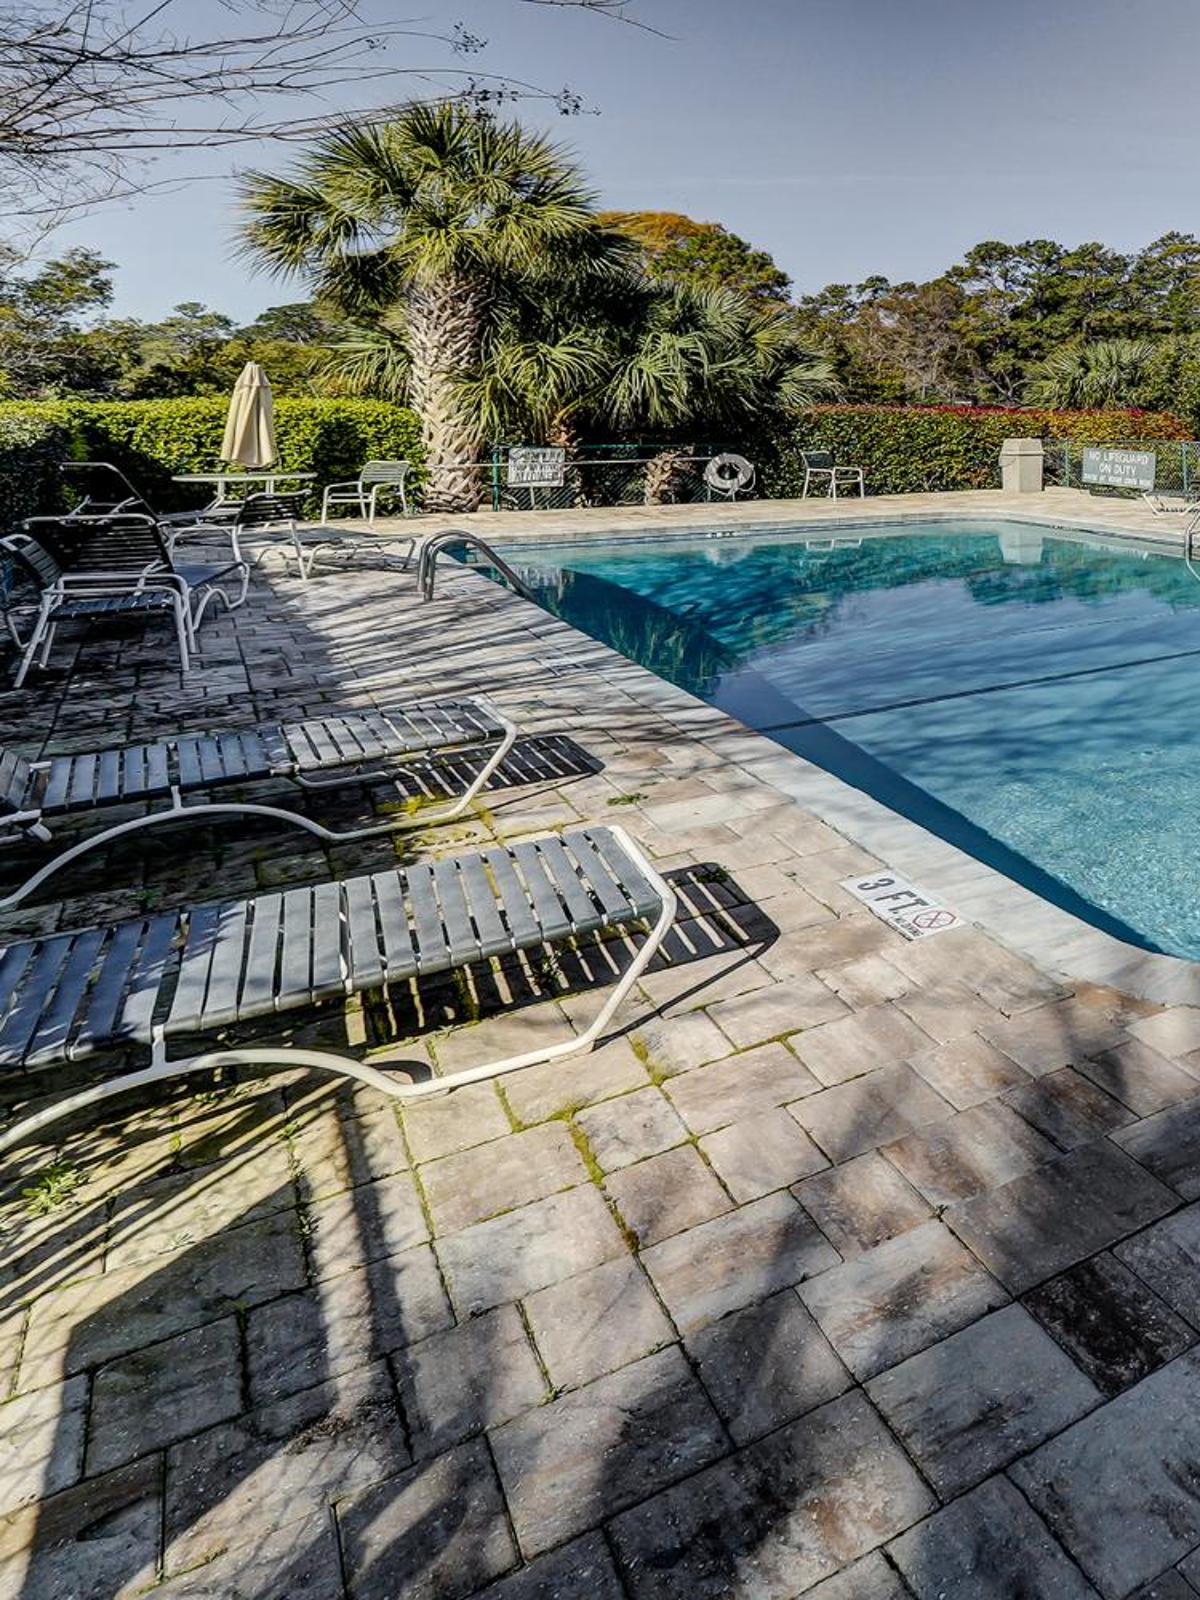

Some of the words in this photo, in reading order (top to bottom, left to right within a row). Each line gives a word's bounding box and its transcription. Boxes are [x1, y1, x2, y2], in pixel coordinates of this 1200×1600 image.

[1089, 450, 1101, 461] NO
[1103, 452, 1149, 465] LIFEGUARD
[1099, 463, 1112, 474] ON
[1113, 464, 1137, 476] DUTY
[857, 878, 895, 891] 3
[874, 890, 929, 914] FT.
